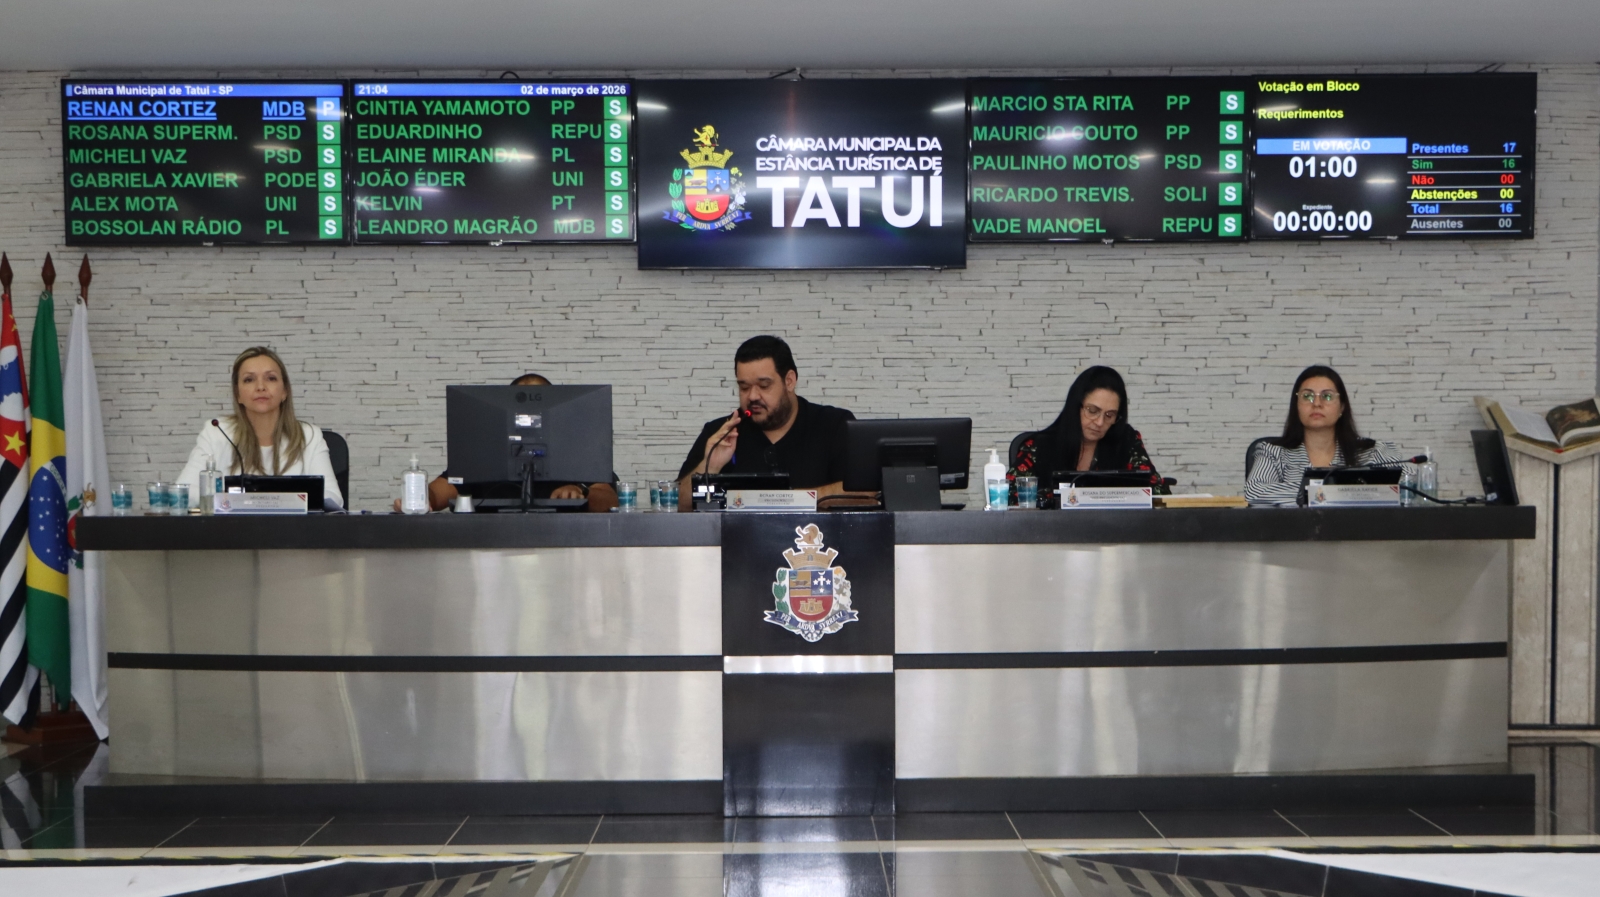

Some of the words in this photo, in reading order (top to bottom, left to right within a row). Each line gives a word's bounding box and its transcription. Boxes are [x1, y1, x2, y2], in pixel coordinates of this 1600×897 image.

[74, 85, 114, 95] Câmara
[116, 85, 166, 96] Municipal
[169, 86, 182, 95] de
[218, 86, 233, 95] SP
[358, 86, 388, 94] 21:04
[521, 86, 533, 94] 02
[536, 86, 549, 94] de
[552, 87, 584, 97] março
[586, 86, 599, 94] de
[602, 86, 626, 94] 2026
[1259, 82, 1303, 93] Votação
[1327, 82, 1360, 91] Bloco
[68, 101, 133, 120] RENAN
[139, 101, 217, 120] CORTEZ
[262, 102, 306, 120] MDB
[323, 102, 334, 115] P
[356, 100, 418, 116] CINTIA
[423, 100, 530, 116] YAMAMOTO
[552, 101, 575, 115] PP
[609, 101, 621, 116] S
[973, 96, 1047, 111] MARCIO
[1053, 96, 1088, 111] STA
[1093, 96, 1134, 110] RITA
[1166, 96, 1190, 110] PP
[1226, 95, 1238, 110] S
[1258, 109, 1344, 121] Requerimentos
[69, 125, 148, 140] ROSANA
[153, 125, 238, 140] SUPERM.
[264, 126, 301, 140] PSD
[323, 125, 335, 140] S
[357, 124, 482, 139] EDUARDINHO
[552, 124, 601, 139] REPU
[610, 124, 622, 139] S
[973, 126, 1066, 140] MAURICIO
[1071, 126, 1138, 140] COUTO
[1166, 126, 1190, 140] PP
[1225, 125, 1237, 140] S
[756, 135, 826, 151] CÂMARA
[829, 137, 915, 151] MUNICIPAL
[917, 137, 942, 151] DA
[1293, 142, 1310, 150] EM
[1313, 139, 1371, 151] VOTAÇÃO
[1412, 143, 1469, 154] Presentes
[1503, 143, 1516, 152] 17
[70, 149, 146, 164] MICHELI
[152, 149, 187, 163] VAZ
[264, 149, 302, 164] PSD
[323, 149, 335, 164] S
[357, 148, 426, 163] ELAINE
[433, 148, 521, 163] MIRANDA
[552, 148, 575, 162] PL
[610, 148, 622, 163] S
[756, 155, 834, 171] ESTÂNCIA
[836, 154, 917, 171] TURÍSTICA
[920, 157, 942, 170] DE
[973, 155, 1067, 170] PAULINHO
[1073, 155, 1140, 170] MOTOS
[1165, 155, 1201, 169] PSD
[1225, 154, 1236, 169] S
[1289, 156, 1357, 178] 01:00
[1412, 160, 1433, 169] Sim
[1502, 159, 1515, 168] 16
[70, 173, 166, 188] GABRIELA
[171, 173, 238, 188] XAVIER
[265, 173, 317, 188] PODE
[324, 173, 336, 188] S
[357, 170, 409, 187] JOÃO
[415, 169, 466, 187] ÉDER
[553, 172, 583, 186] UNI
[610, 172, 622, 187] S
[1412, 174, 1434, 185] Não
[1500, 174, 1514, 184] 00
[756, 170, 943, 228] TATUÍ
[973, 187, 1057, 202] RICARDO
[1064, 187, 1134, 202] TREVIS.
[1164, 187, 1206, 202] SOLI
[1224, 186, 1236, 201] S
[1411, 189, 1478, 201] Abstenções
[1500, 189, 1513, 199] 00
[71, 197, 120, 211] ALEX
[126, 197, 178, 211] MOTA
[265, 197, 296, 211] UNI
[324, 197, 336, 211] S
[357, 197, 422, 211] KELVIN
[553, 197, 575, 210] PT
[611, 196, 623, 211] S
[1411, 204, 1439, 214] Total
[1500, 204, 1513, 213] 16
[72, 221, 176, 235] BOSSOLAN
[183, 216, 242, 235] RÁDIO
[266, 221, 289, 234] PL
[325, 220, 337, 235] S
[358, 220, 448, 234] LEANDRO
[454, 217, 538, 234] MAGRÃO
[554, 220, 595, 234] MDB
[612, 220, 623, 234] S
[972, 219, 1021, 233] VADE
[1027, 219, 1106, 233] MANOEL
[1163, 218, 1212, 233] REPU
[1224, 217, 1236, 232] S
[1273, 211, 1372, 231] 00:00:00
[1411, 219, 1463, 229] Ausentes
[1499, 219, 1512, 228] 00
